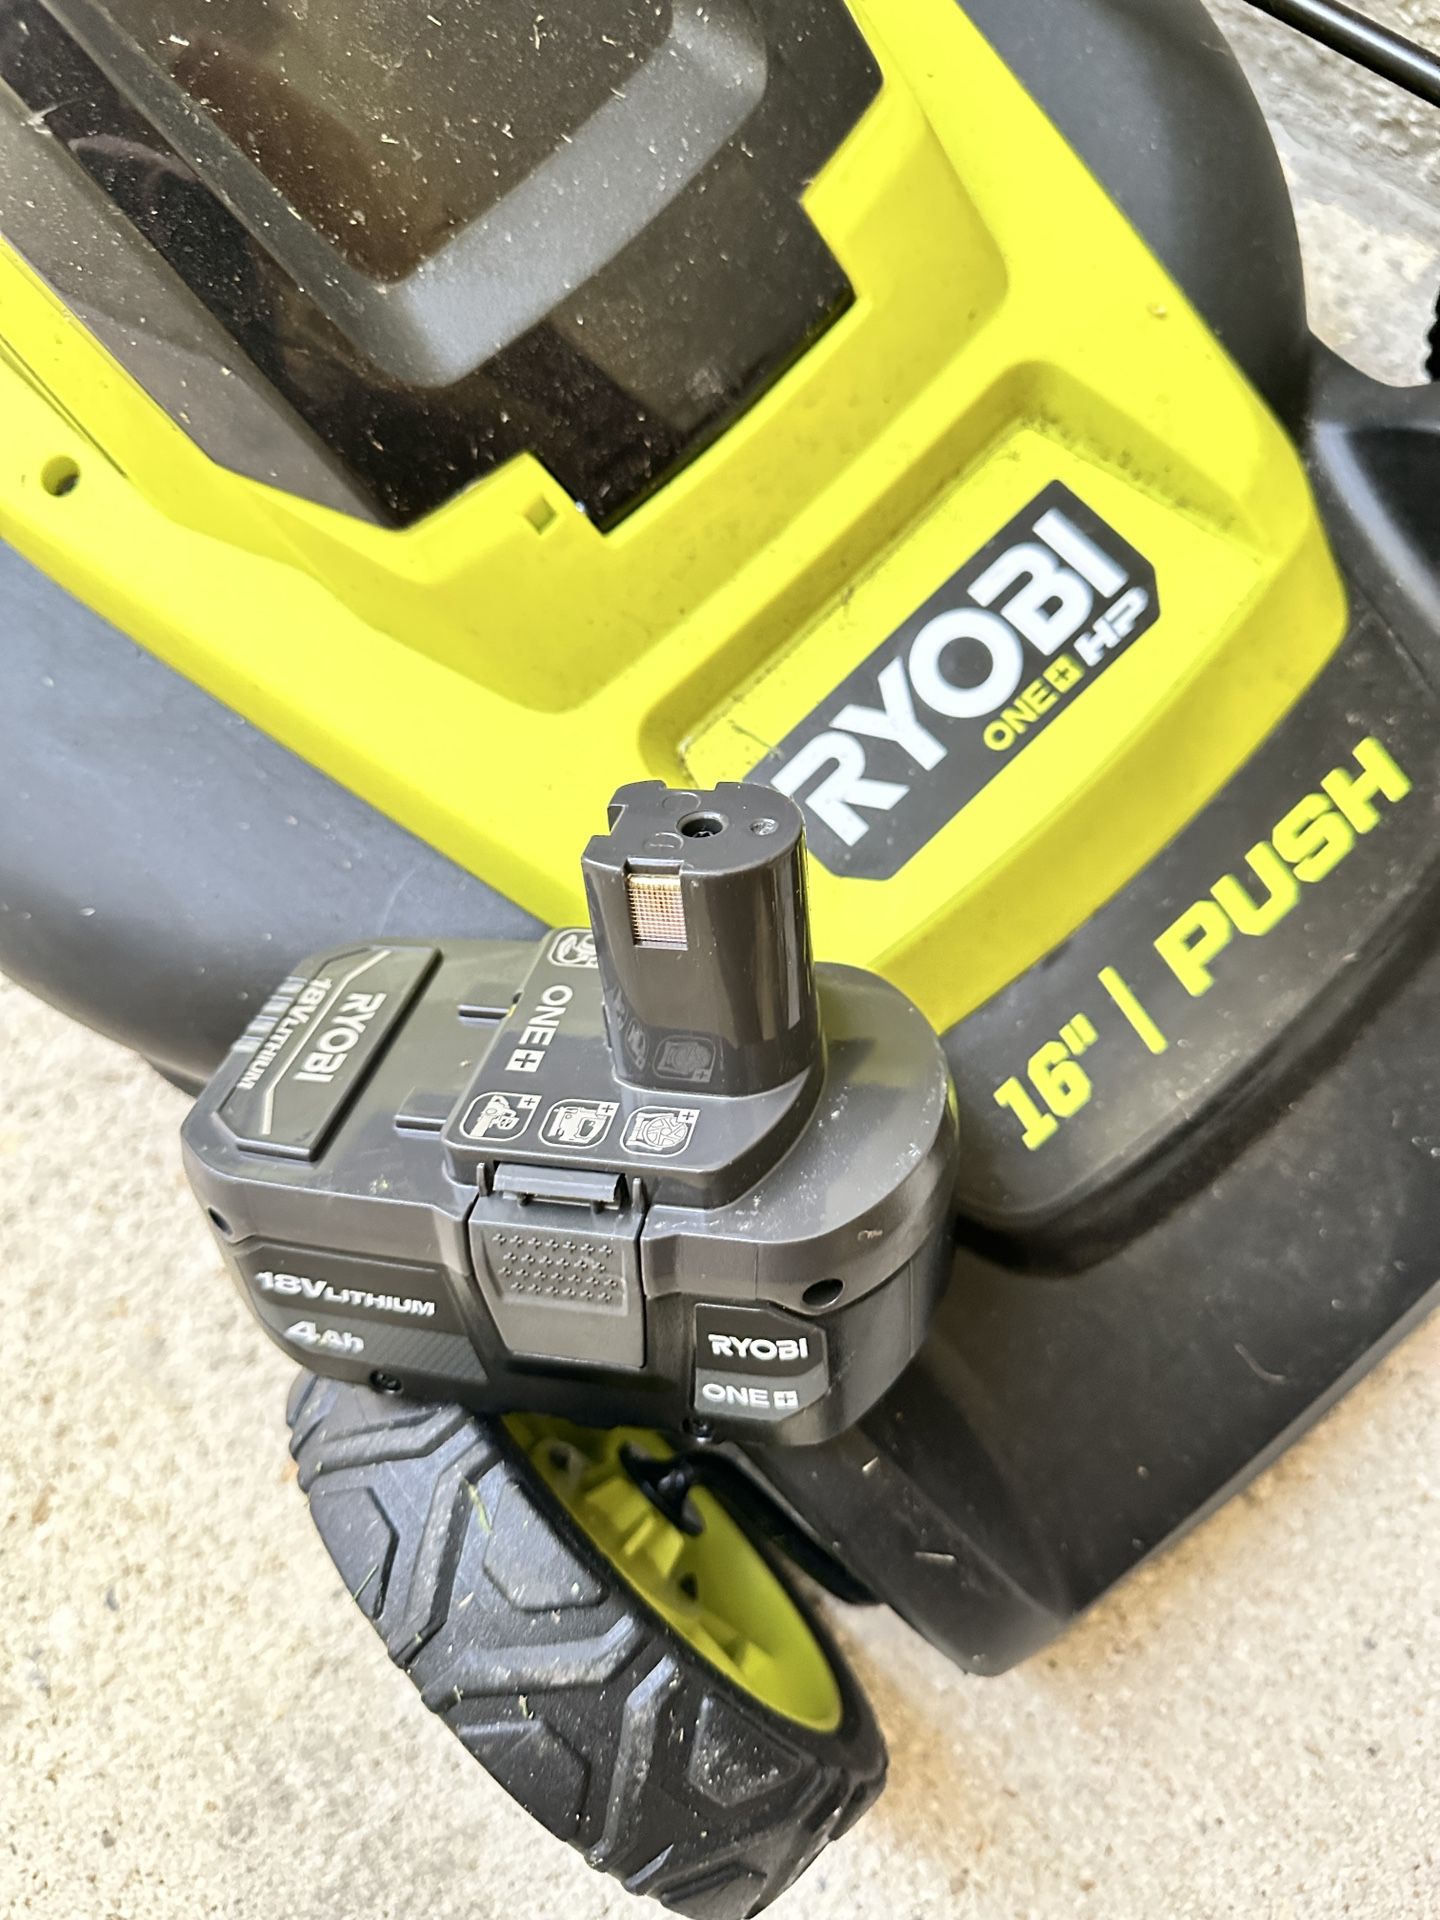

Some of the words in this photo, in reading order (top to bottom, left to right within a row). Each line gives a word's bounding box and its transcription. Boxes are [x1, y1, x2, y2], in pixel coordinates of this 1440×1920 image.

[1072, 586, 1149, 667] HP
[771, 507, 1128, 846] RYOBI
[1153, 737, 1411, 997] PUSH
[293, 992, 387, 1083] RYOBI
[284, 1320, 364, 1354] 4Ah
[708, 1333, 809, 1361] RYOBI
